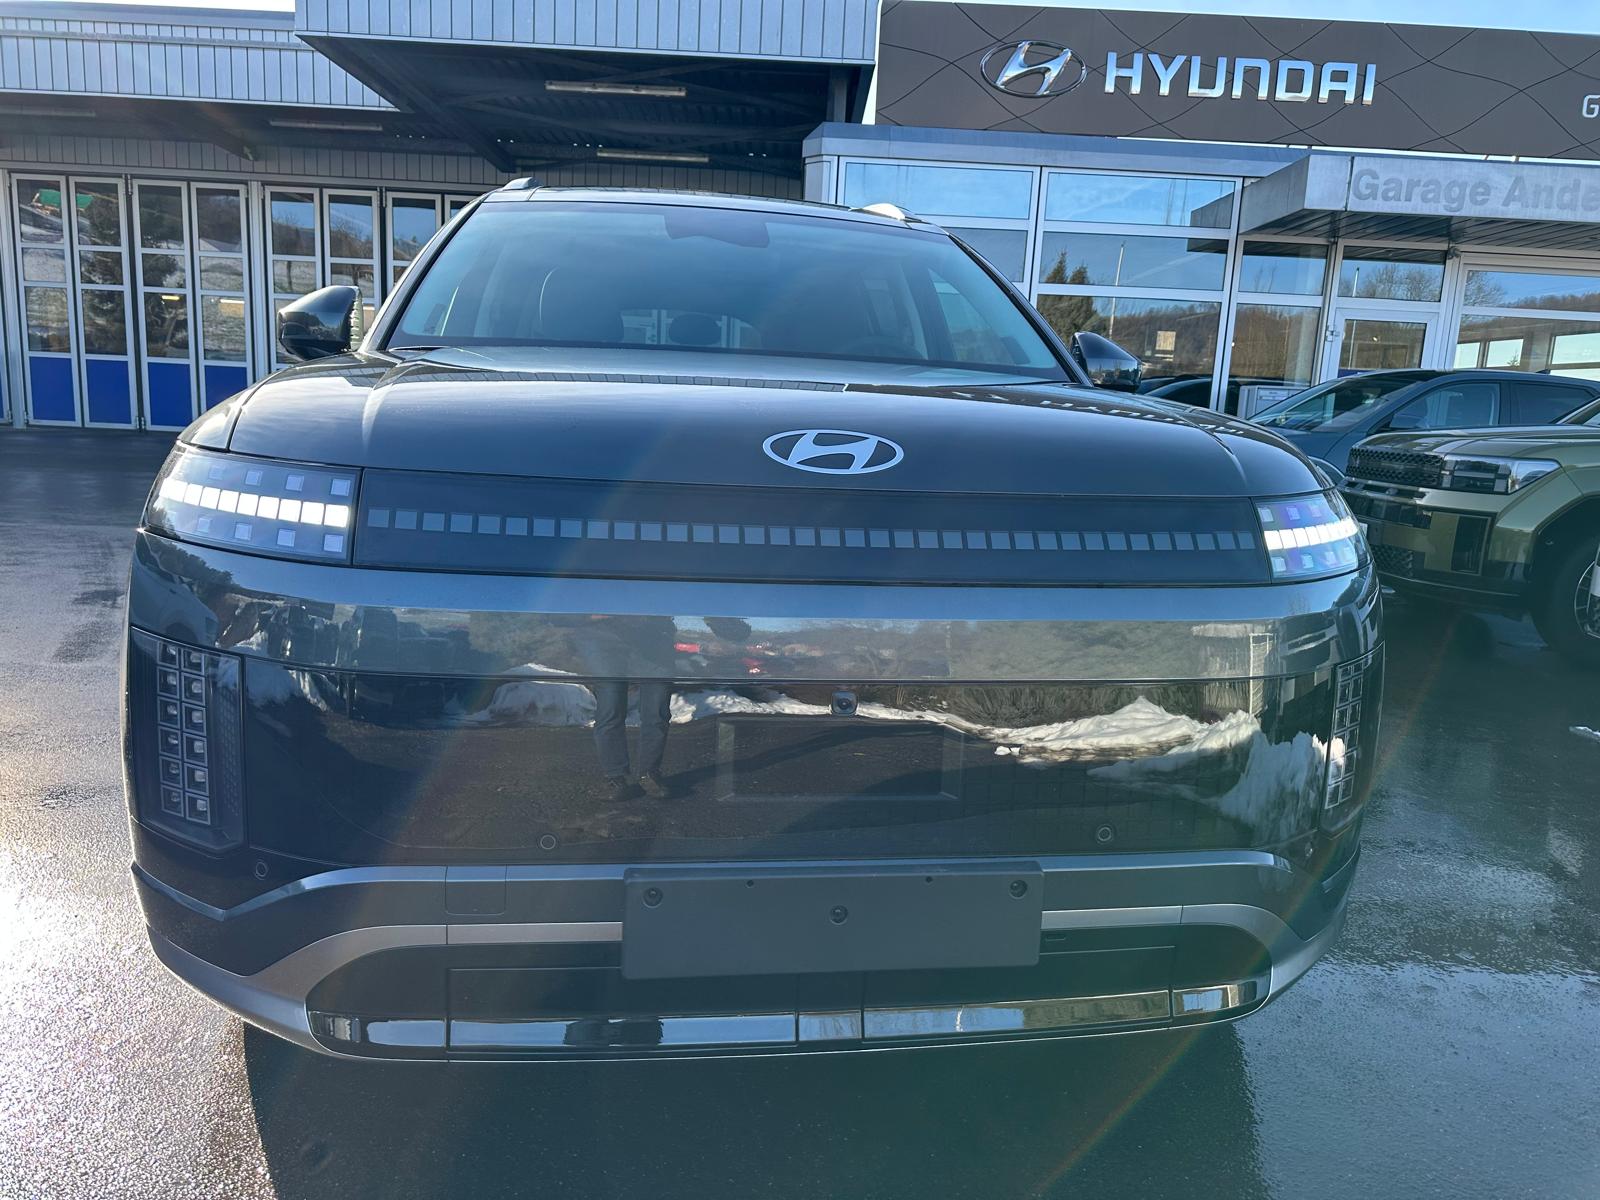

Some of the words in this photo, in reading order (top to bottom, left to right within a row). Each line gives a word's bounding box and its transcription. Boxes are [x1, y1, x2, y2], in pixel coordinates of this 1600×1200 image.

[1104, 51, 1377, 105] HYUNDAI
[1351, 168, 1492, 213] Garage
[1501, 175, 1600, 212] Ande
